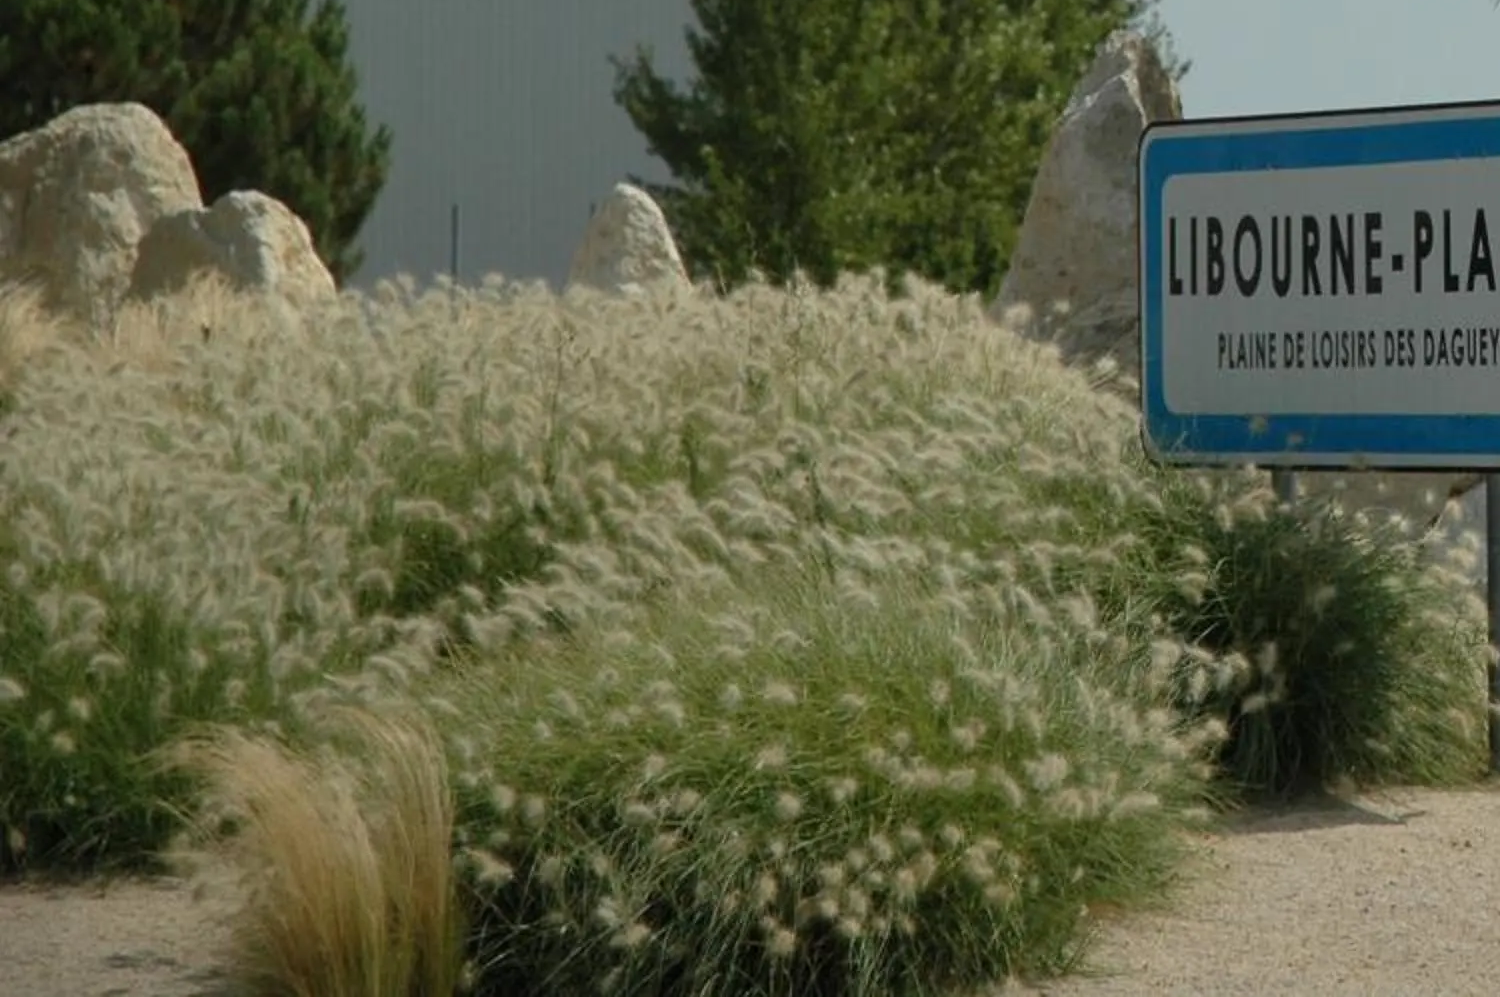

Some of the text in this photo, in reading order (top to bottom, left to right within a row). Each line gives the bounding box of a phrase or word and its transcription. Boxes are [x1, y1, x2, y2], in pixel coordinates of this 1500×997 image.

[1218, 332, 1277, 369] PLAINE
[1283, 332, 1305, 368] DE
[1311, 330, 1376, 368] LOISIRS
[1384, 329, 1415, 367] DES
